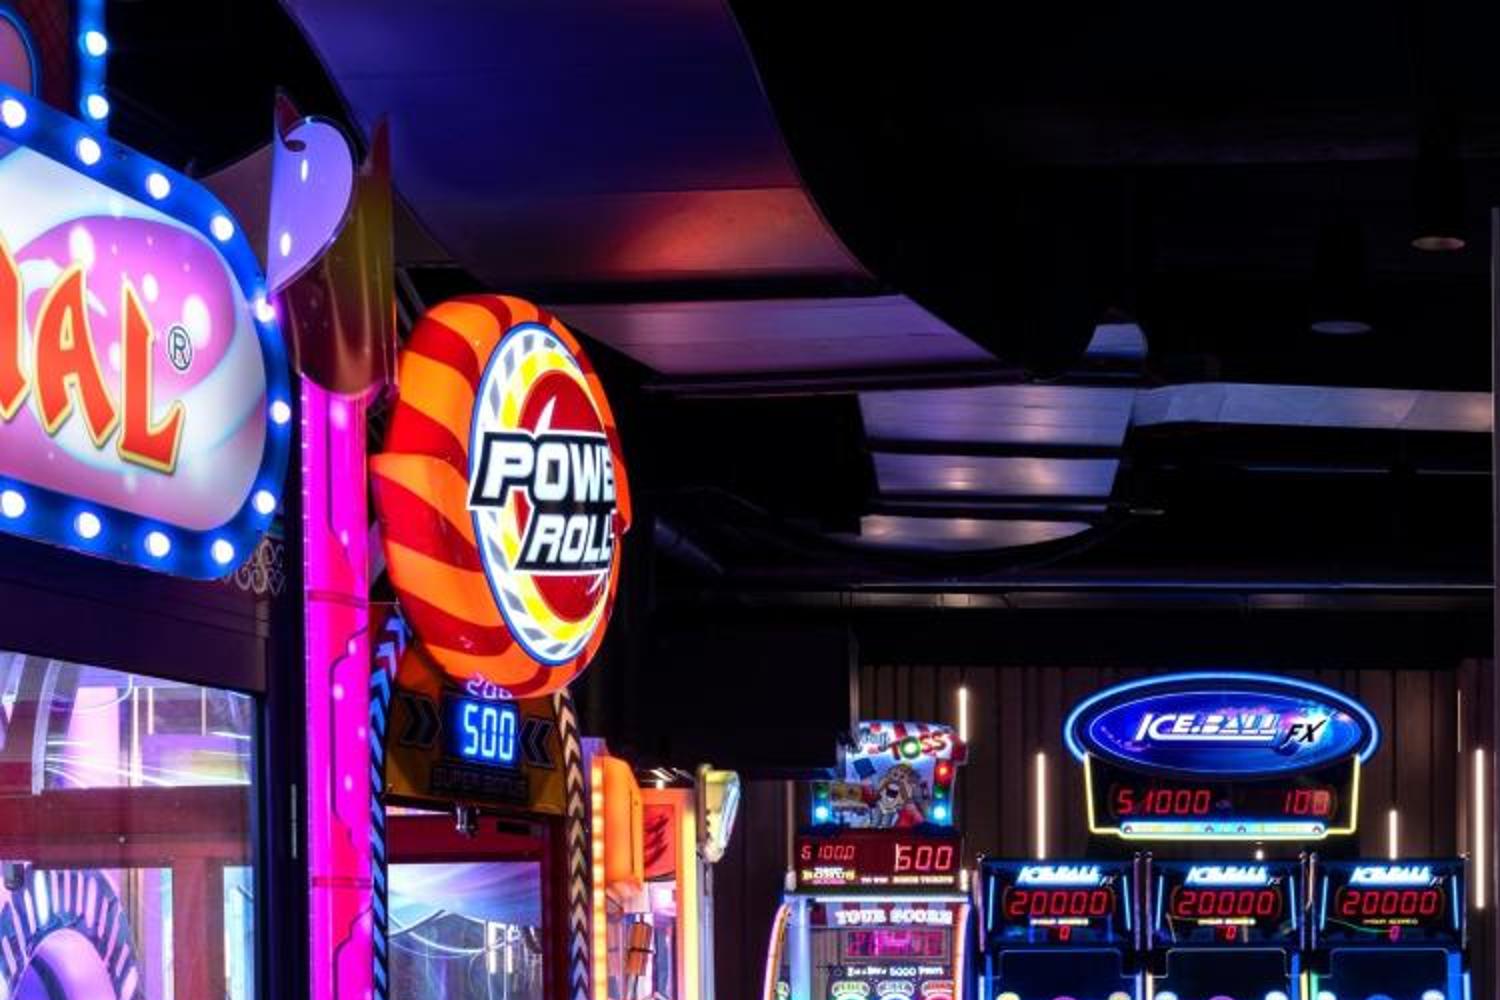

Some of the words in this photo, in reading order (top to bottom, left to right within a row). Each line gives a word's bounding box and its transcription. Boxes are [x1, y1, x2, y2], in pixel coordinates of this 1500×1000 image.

[481, 440, 617, 503] POWE
[463, 702, 515, 761] 500
[1009, 891, 1107, 915] 20000
[1179, 891, 1274, 915] 20000
[1343, 891, 1437, 915] 20000
[836, 911, 886, 924] YOUR
[890, 910, 952, 924] SCORE
